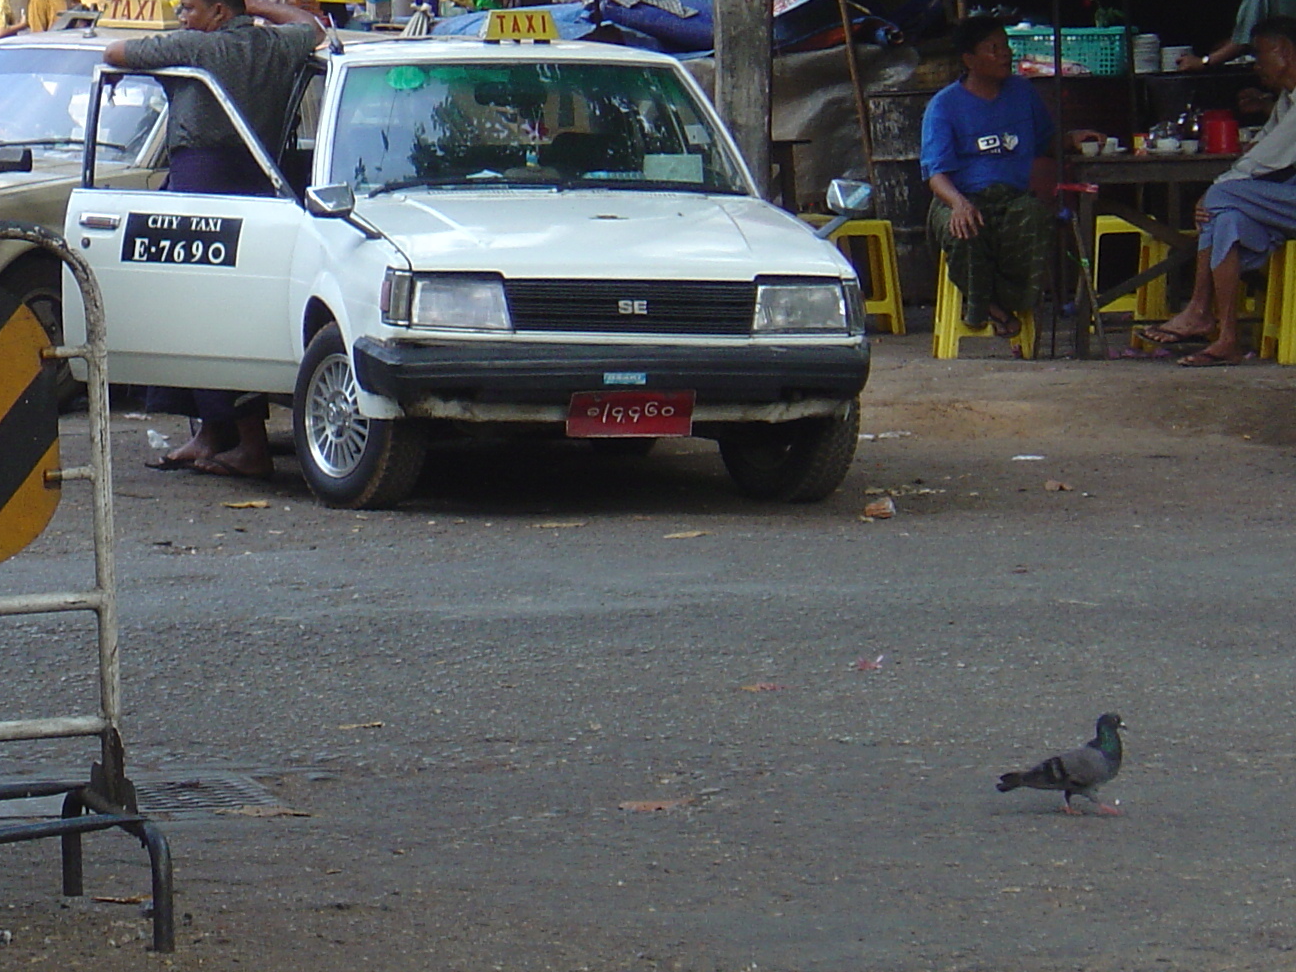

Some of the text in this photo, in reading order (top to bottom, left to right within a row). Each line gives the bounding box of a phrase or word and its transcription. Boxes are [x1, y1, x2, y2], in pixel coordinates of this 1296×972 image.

[495, 14, 547, 34] TAXI
[147, 214, 223, 232] CITY TAXI
[617, 299, 648, 315] SE
